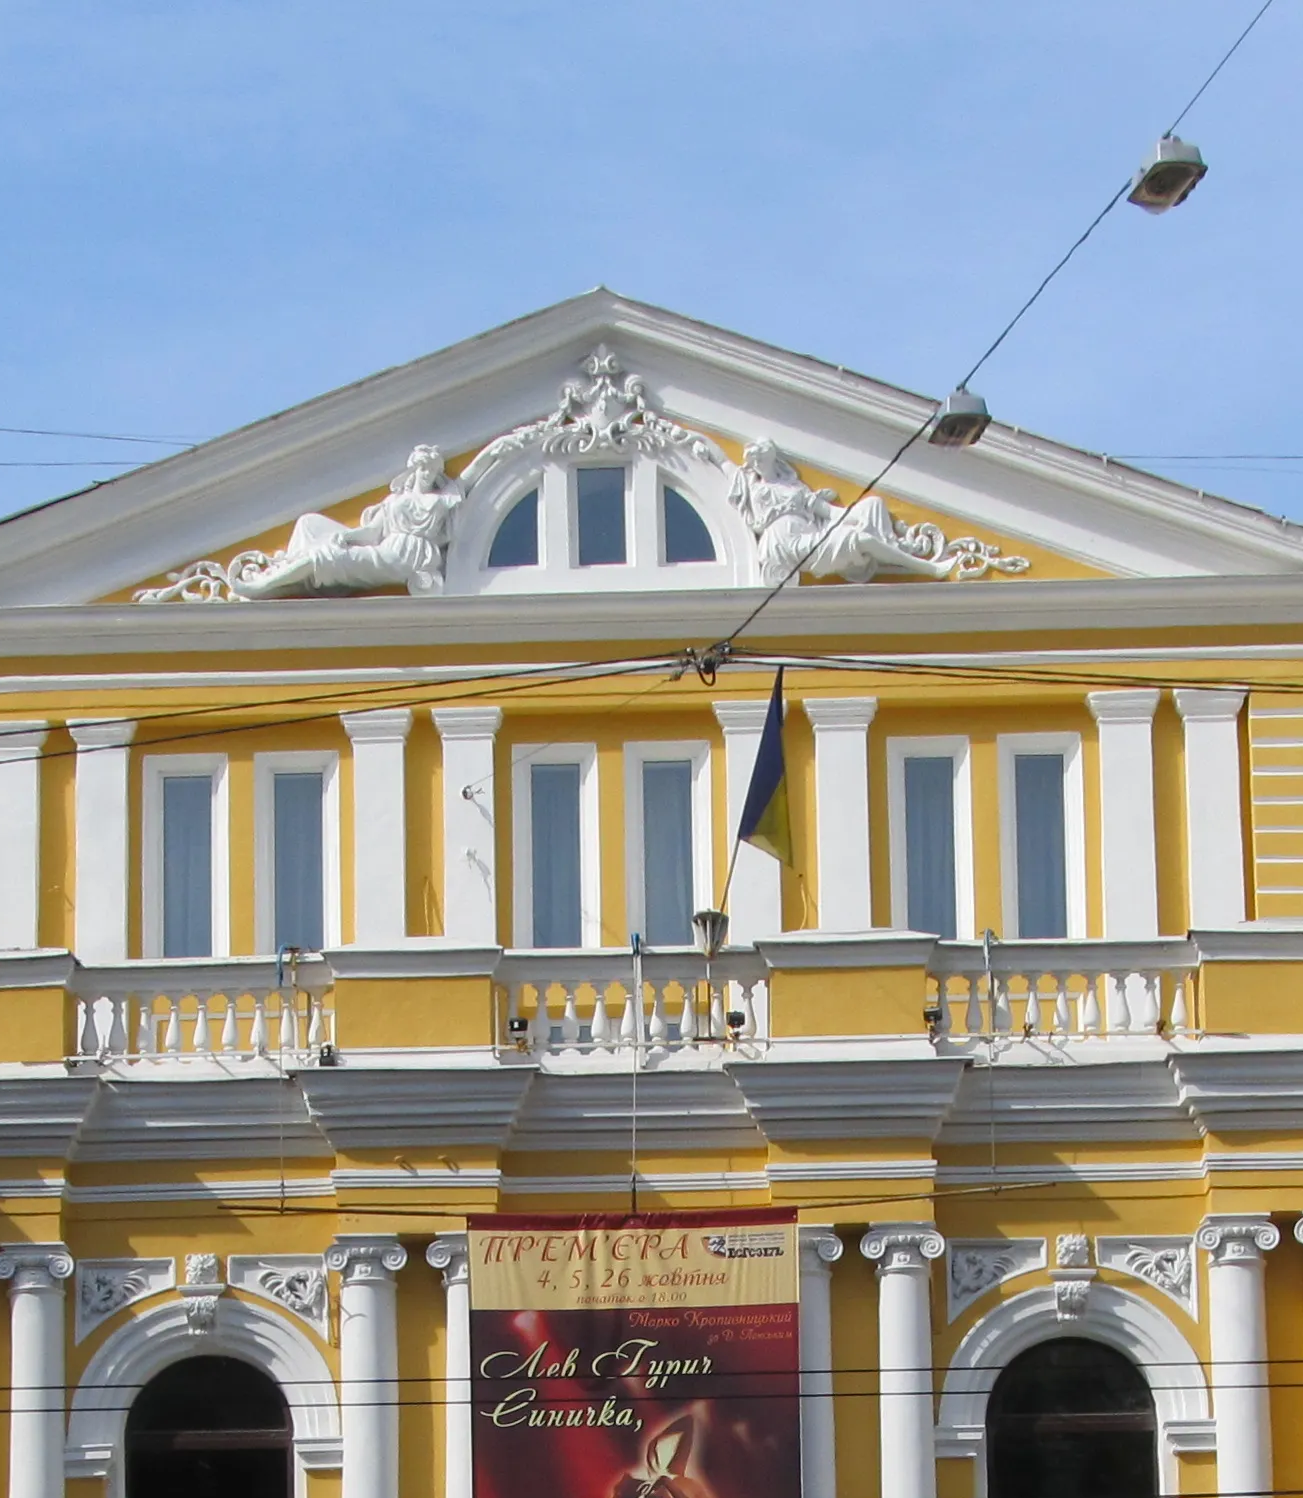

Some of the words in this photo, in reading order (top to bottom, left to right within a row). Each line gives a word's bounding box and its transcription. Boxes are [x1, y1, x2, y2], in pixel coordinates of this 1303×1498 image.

[479, 1233, 689, 1265] ПРЕМ'ЄРА
[537, 1270, 557, 1291] 4,
[571, 1269, 590, 1288] 5,
[601, 1268, 630, 1288] 26
[638, 1267, 728, 1287] жовтня
[576, 1294, 634, 1305] початок
[651, 1292, 687, 1302] 18.00
[629, 1312, 680, 1327] Марко
[684, 1309, 792, 1327] Кропивницький
[480, 1341, 580, 1379] Лев
[592, 1337, 713, 1390] Гурич
[480, 1388, 644, 1431] Синичка,
